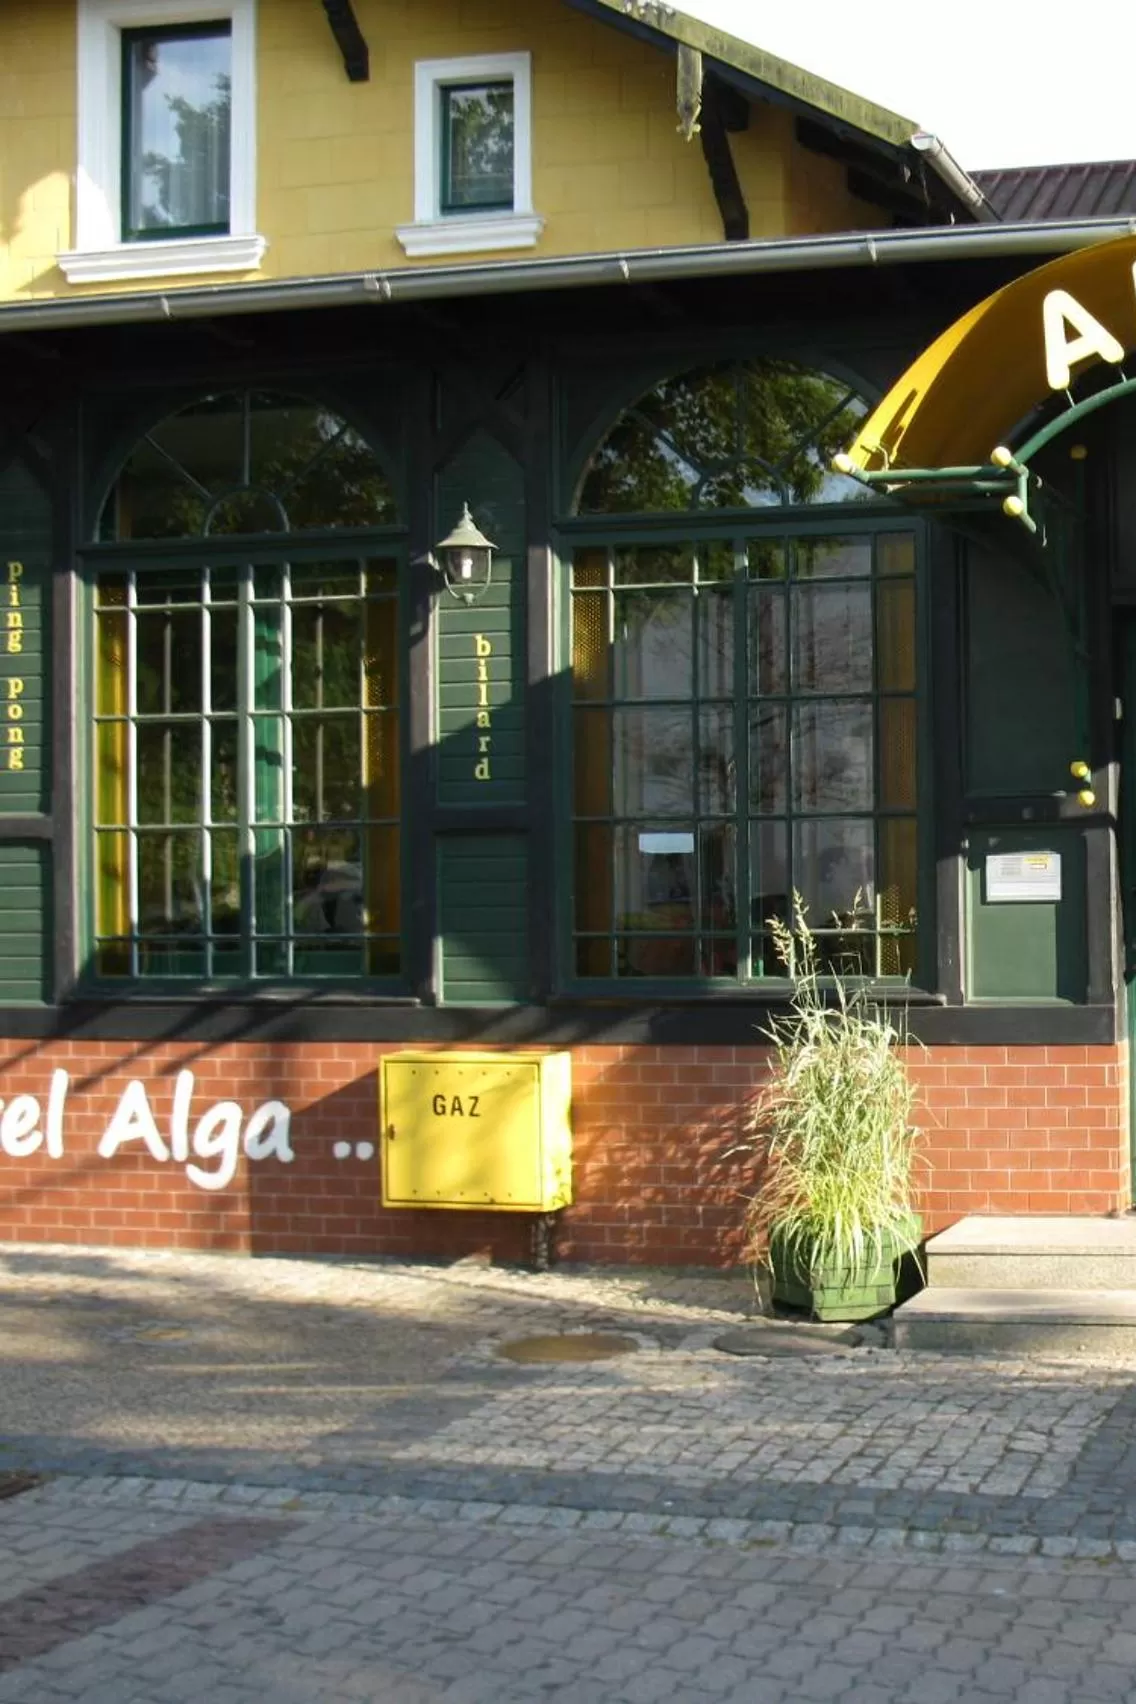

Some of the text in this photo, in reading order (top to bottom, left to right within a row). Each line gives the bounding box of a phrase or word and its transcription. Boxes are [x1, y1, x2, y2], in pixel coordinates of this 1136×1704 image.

[7, 561, 25, 770] ping pong
[474, 633, 492, 780] bilard
[0, 1068, 69, 1160] el
[98, 1069, 295, 1190] Alga
[432, 1094, 482, 1118] GAZ
